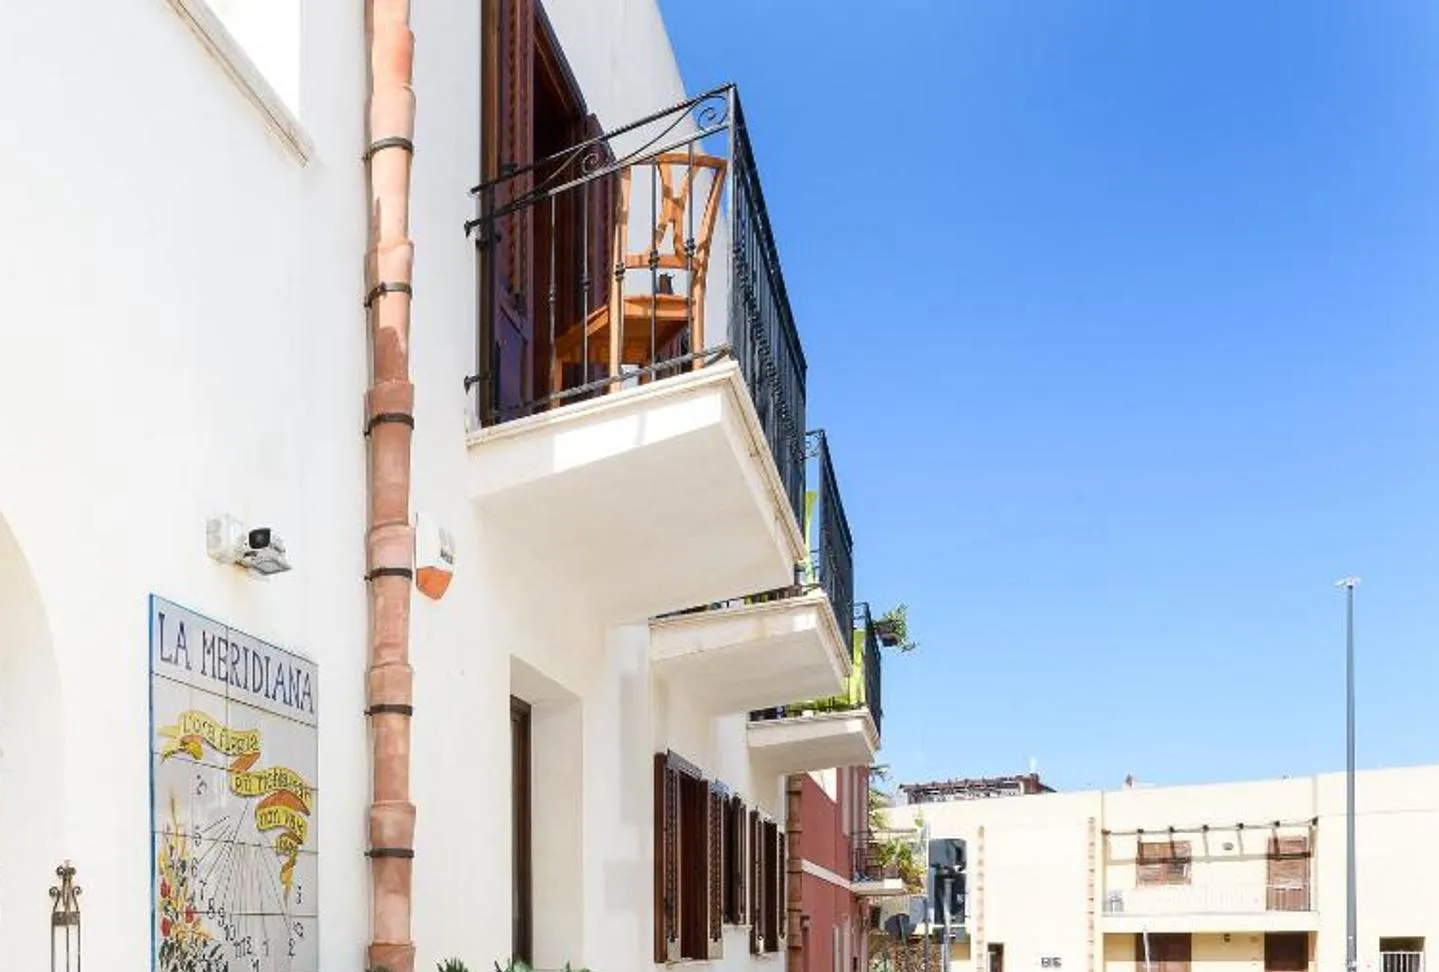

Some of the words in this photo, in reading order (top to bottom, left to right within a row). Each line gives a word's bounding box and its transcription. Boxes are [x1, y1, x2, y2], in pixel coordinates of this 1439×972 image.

[158, 611, 192, 671] LA
[201, 630, 315, 715] MERIDIANA
[217, 907, 225, 928] 9
